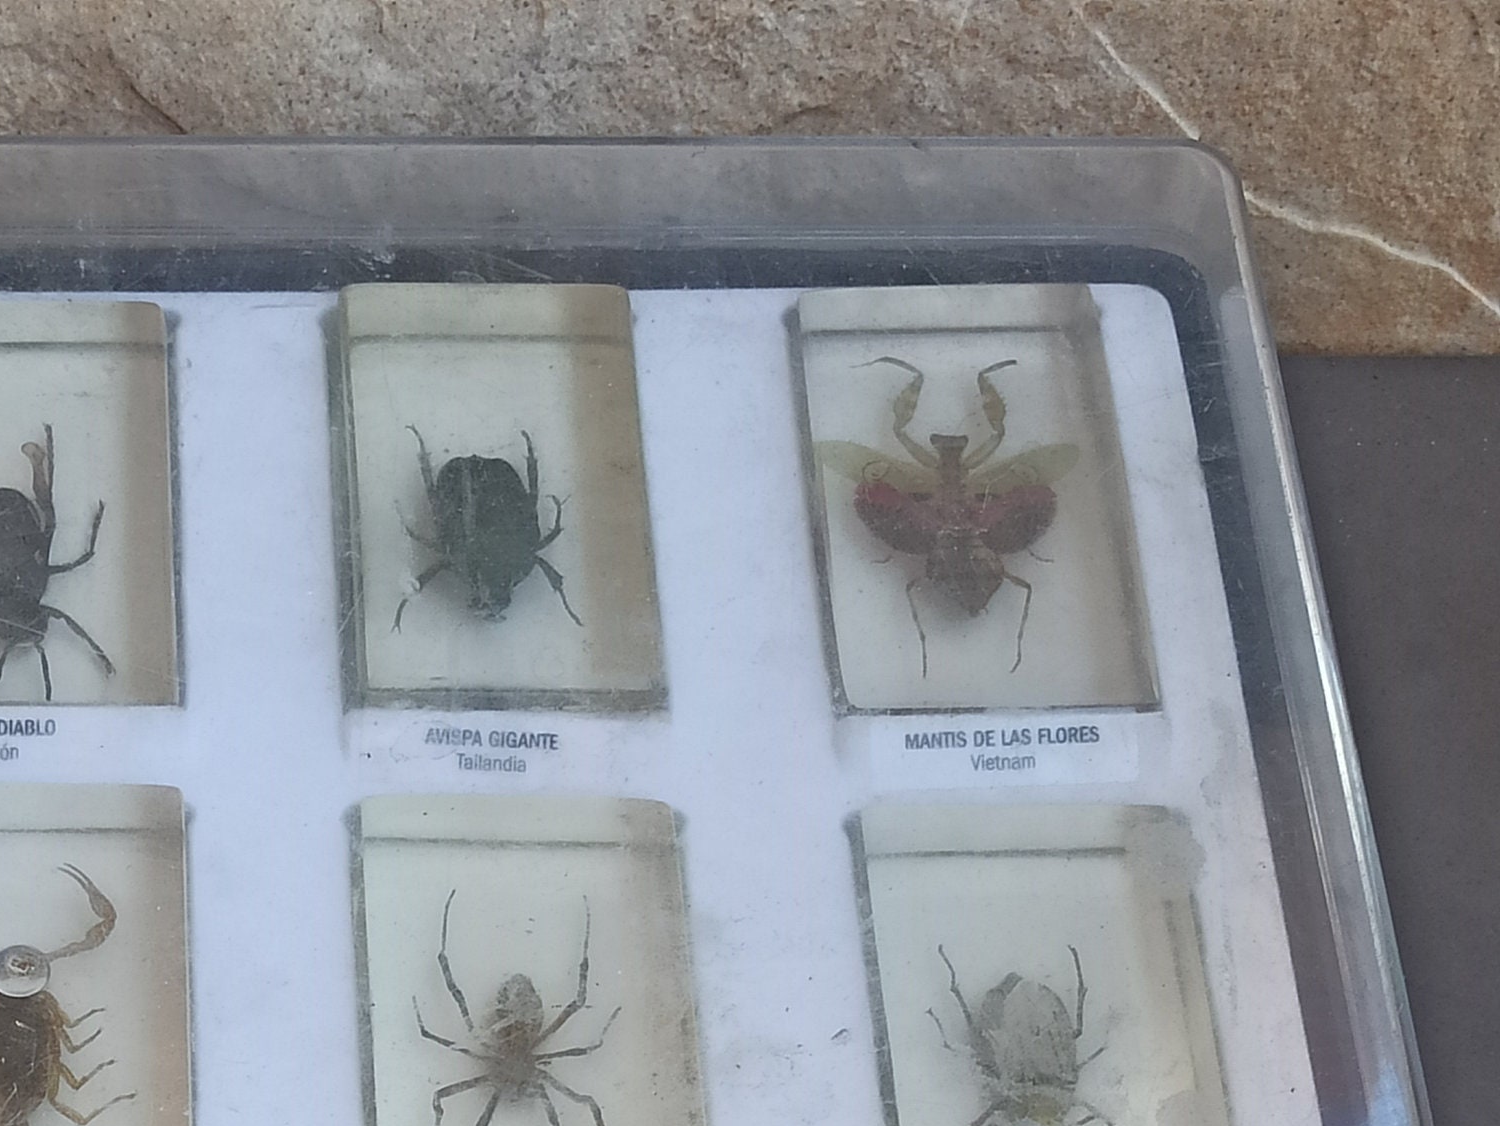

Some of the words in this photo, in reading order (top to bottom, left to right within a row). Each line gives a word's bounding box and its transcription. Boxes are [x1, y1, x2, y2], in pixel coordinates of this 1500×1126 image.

[424, 727, 483, 747] AVISPA
[488, 729, 560, 750] GIGANTE
[905, 731, 967, 750] MANTIS
[973, 730, 996, 748] DE
[1000, 728, 1032, 746] LAS
[1038, 726, 1100, 745] FLORES
[456, 752, 528, 773] Tailandia
[970, 753, 1036, 772] Vietnam
